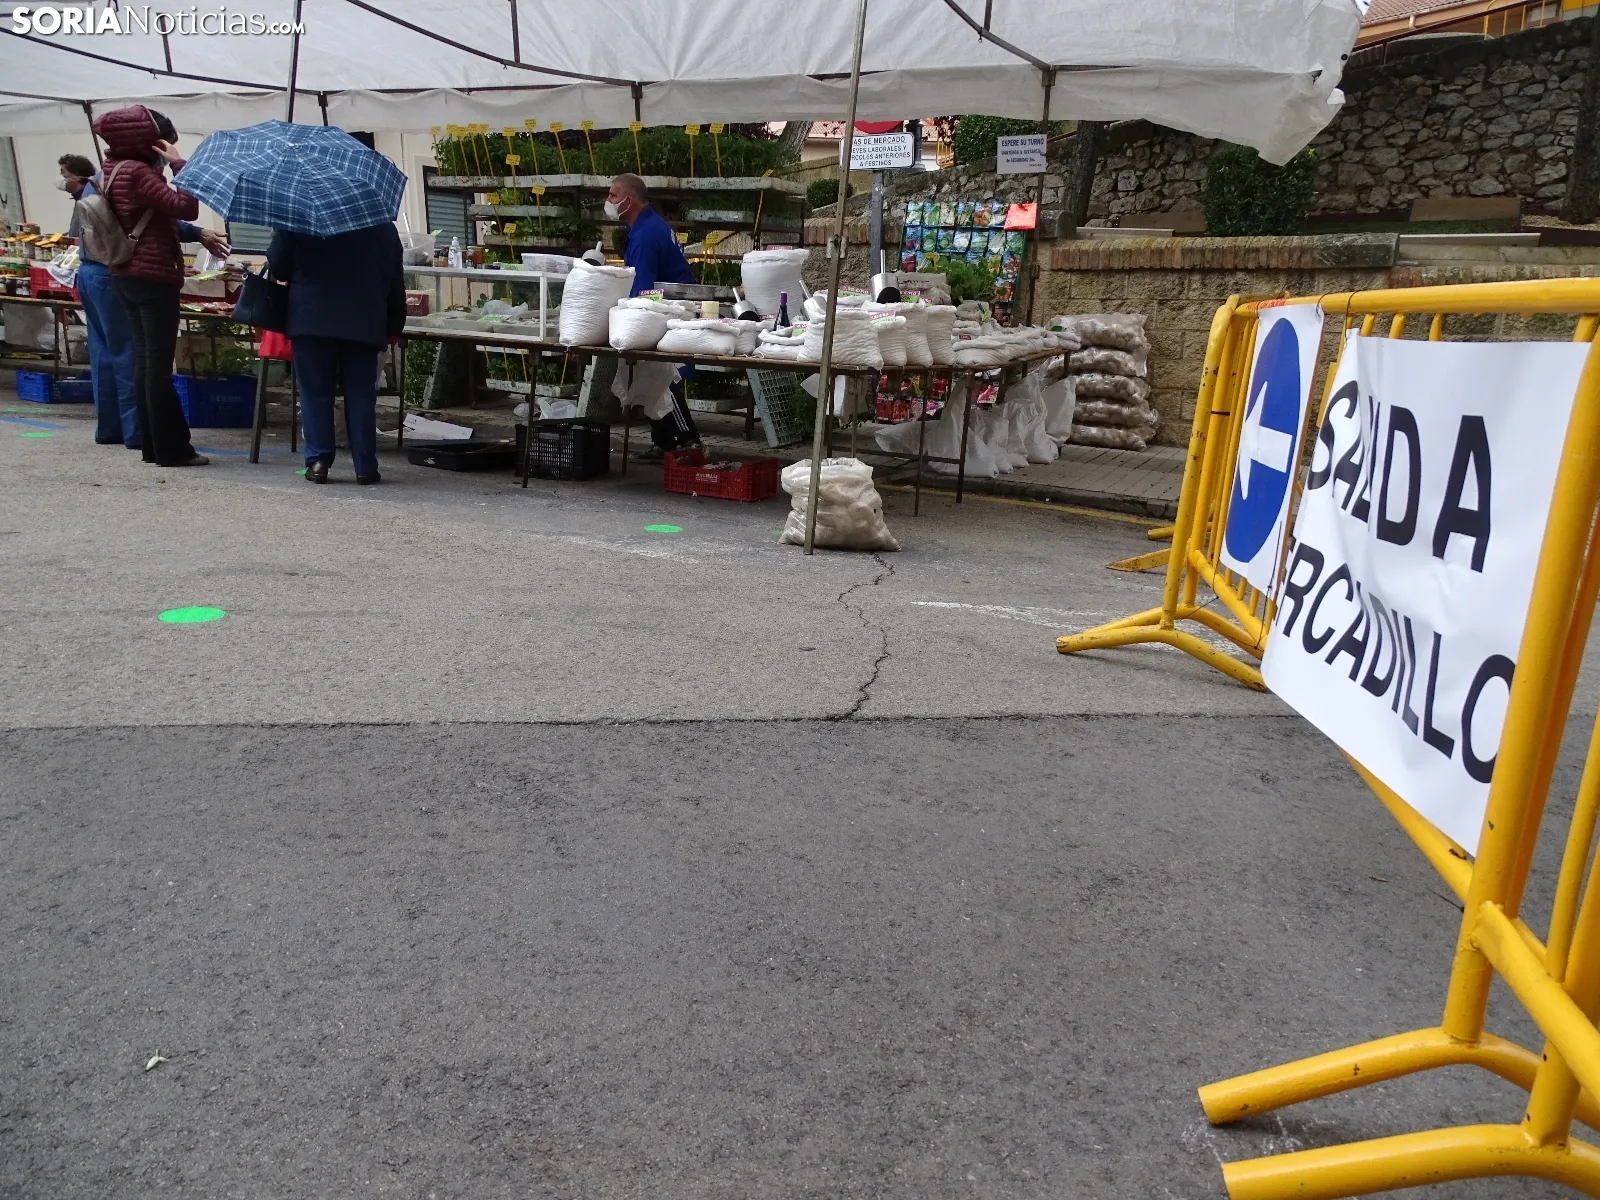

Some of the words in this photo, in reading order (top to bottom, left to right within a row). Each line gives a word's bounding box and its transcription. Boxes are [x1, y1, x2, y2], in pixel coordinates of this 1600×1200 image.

[863, 137, 872, 145] DE
[873, 135, 906, 144] MERCADO
[1001, 139, 1019, 147] ESPERE
[1020, 138, 1027, 146] SU
[1028, 137, 1044, 146] TURNO
[874, 151, 911, 159] ANTERIORES
[864, 159, 892, 167] FESTIVOS
